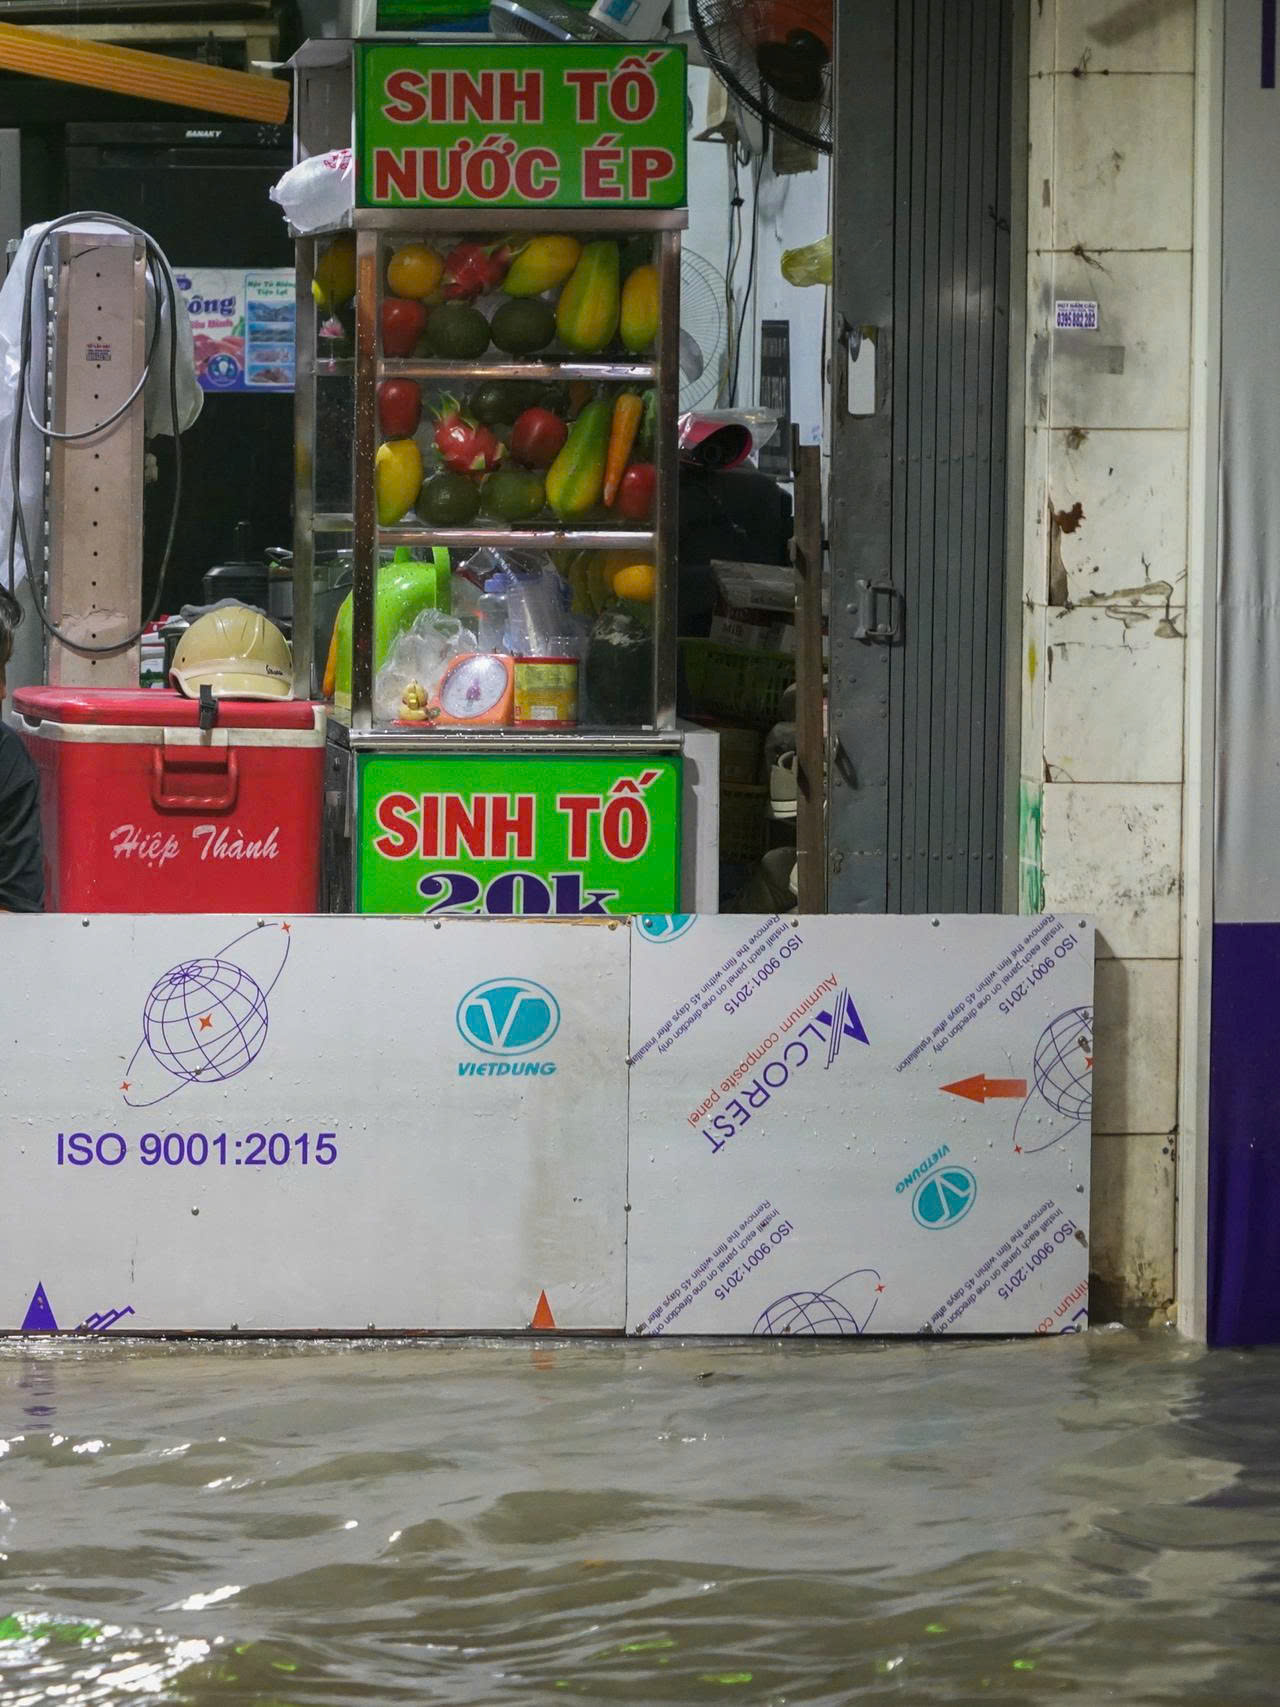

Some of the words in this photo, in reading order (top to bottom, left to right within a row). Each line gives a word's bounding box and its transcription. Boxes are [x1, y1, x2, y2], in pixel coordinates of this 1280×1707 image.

[382, 69, 544, 124] SINH
[565, 49, 669, 124] TỐ
[374, 135, 560, 200] NƯỚC
[582, 133, 675, 200] ÉP
[187, 295, 236, 316] ông
[373, 792, 536, 860] SINH
[556, 769, 664, 862] TỐ
[110, 824, 181, 867] Hiệp
[192, 824, 280, 860] Thành
[417, 870, 619, 913] 20k
[765, 922, 789, 947] Install
[1024, 914, 1055, 944] Remove
[1040, 922, 1064, 946] Install
[736, 944, 749, 957] the
[747, 944, 765, 964] each
[779, 934, 803, 958] ISO
[1010, 944, 1024, 958] the
[1022, 944, 1040, 964] each
[1054, 934, 1077, 958] ISO
[722, 957, 737, 971] film
[726, 962, 747, 986] panel
[997, 956, 1012, 971] film
[1001, 961, 1023, 985] panel
[701, 971, 722, 992] within
[716, 984, 726, 995] on
[724, 957, 780, 1014] 9001:2015
[976, 970, 997, 992] within
[990, 983, 1001, 994] on
[999, 957, 1055, 1014] 9001:2015
[690, 993, 701, 1004] 45
[702, 995, 716, 1009] one
[779, 973, 837, 1032] Aluminum
[965, 992, 976, 1004] 45
[977, 994, 991, 1009] one
[672, 1003, 690, 1021] days
[947, 1002, 965, 1021] days
[656, 1020, 672, 1038] after
[673, 1009, 702, 1038] direction
[932, 1019, 947, 1037] after
[948, 1008, 977, 1038] direction
[658, 1037, 673, 1054] only
[896, 1036, 933, 1072] installation
[933, 1037, 948, 1054] only
[458, 1062, 556, 1076] VIETDUNG
[702, 988, 869, 1153] ALCOREST
[720, 1032, 778, 1091] composite
[687, 1089, 720, 1128] panel
[59, 1133, 126, 1165] ISO
[140, 1132, 337, 1166] 9001:2015
[895, 1144, 951, 1194] VIETDUNG
[739, 1200, 771, 1230] Remove
[756, 1209, 779, 1232] Install
[1023, 1200, 1054, 1230] Remove
[1040, 1208, 1063, 1232] Install
[727, 1230, 740, 1243] the
[738, 1230, 756, 1249] each
[770, 1220, 793, 1244] ISO
[1010, 1229, 1023, 1242] the
[1021, 1230, 1040, 1249] each
[1053, 1220, 1077, 1243] ISO
[712, 1242, 728, 1257] film
[717, 1247, 737, 1272] panel
[996, 1242, 1011, 1256] film
[1000, 1247, 1021, 1271] panel
[691, 1257, 713, 1278] within
[706, 1269, 717, 1281] on
[714, 1243, 770, 1300] 9001:2015
[974, 1256, 997, 1278] within
[990, 1269, 1000, 1280] on
[998, 1242, 1054, 1299] 9001:2015
[680, 1278, 691, 1291] 45
[692, 1280, 707, 1295] one
[964, 1278, 975, 1290] 45
[976, 1280, 990, 1294] one
[662, 1289, 680, 1307] days
[946, 1287, 964, 1306] days
[647, 1306, 663, 1324] after
[663, 1294, 693, 1324] direction
[931, 1305, 947, 1323] after
[947, 1294, 976, 1323] direction
